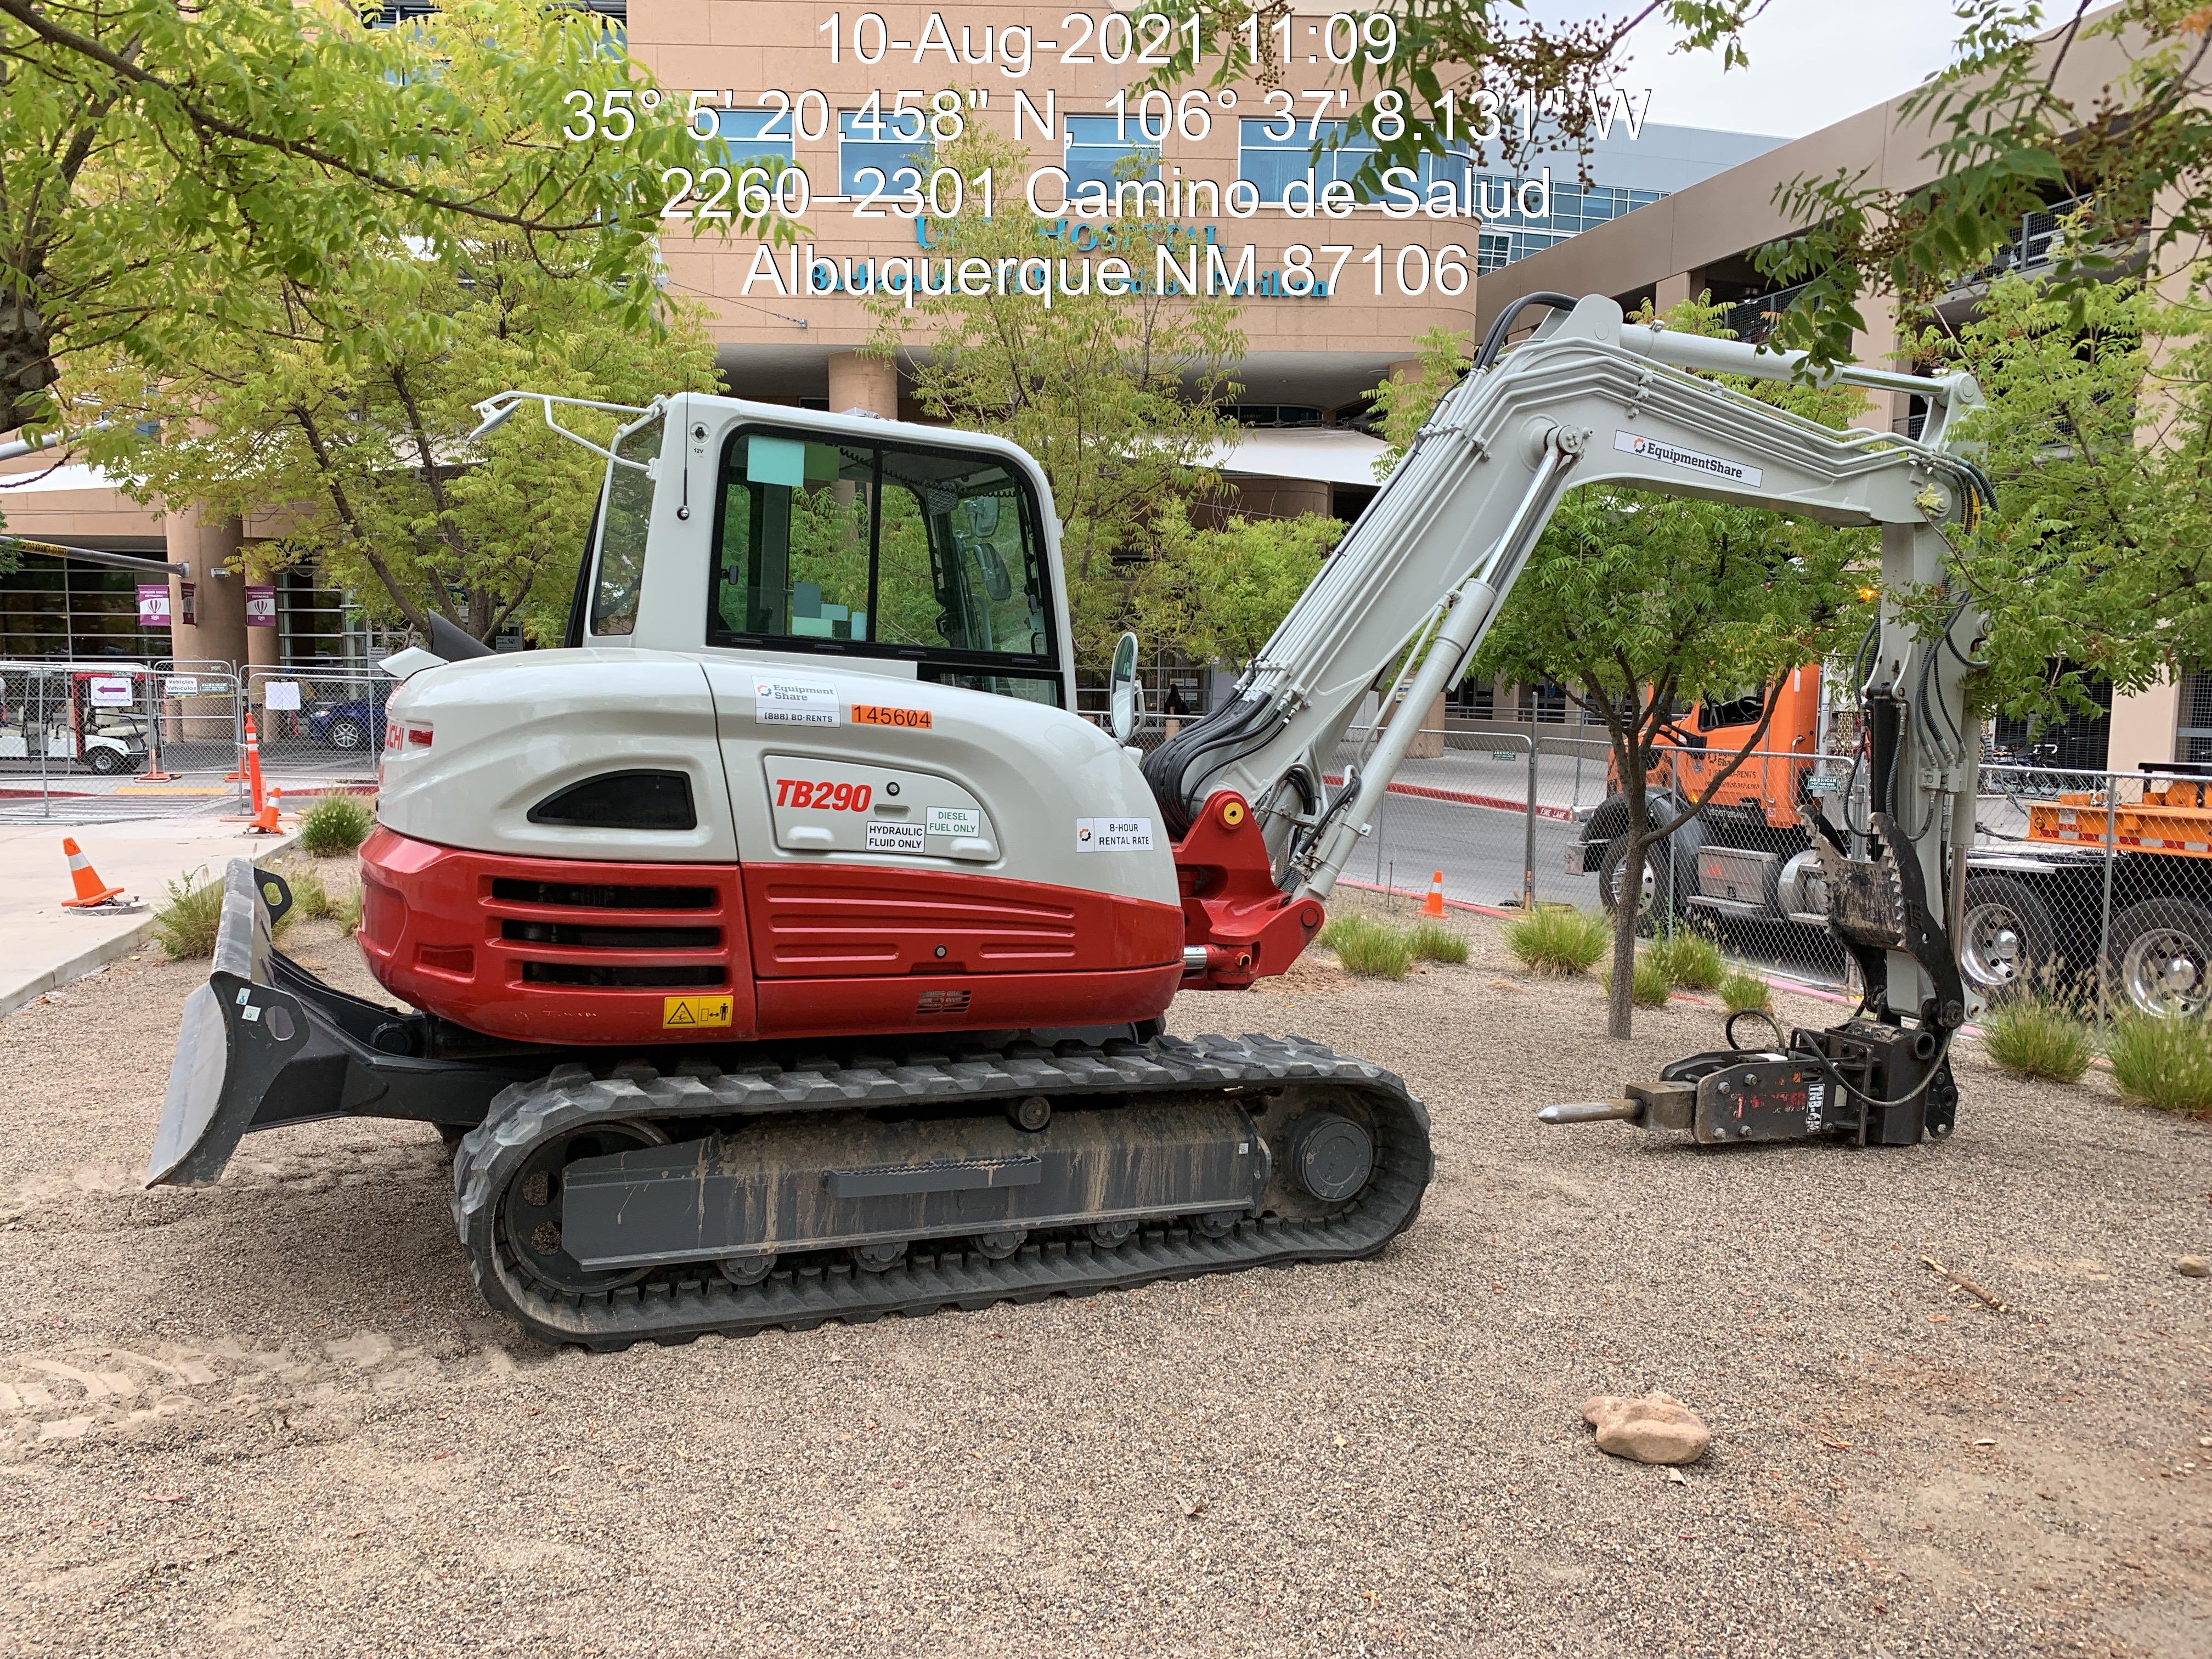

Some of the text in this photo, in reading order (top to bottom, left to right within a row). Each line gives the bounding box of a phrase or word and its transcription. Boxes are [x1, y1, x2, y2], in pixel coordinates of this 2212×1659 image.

[1647, 442, 1742, 478] EquipmentShare
[772, 684, 835, 695] Equipment
[775, 692, 808, 701] Share
[764, 712, 833, 723] (888) 80-RENTS
[853, 704, 931, 728] 145604
[776, 779, 871, 812] TB290
[938, 812, 968, 821] DIESEL
[1540, 808, 1567, 819] FIRE LANE
[869, 826, 923, 836] HYDRAULIC
[929, 822, 977, 833] FUEL ONLY
[1110, 823, 1138, 832] 8-HOUR
[869, 838, 922, 849] FLUID ONLY
[1099, 837, 1130, 845] RENTAL
